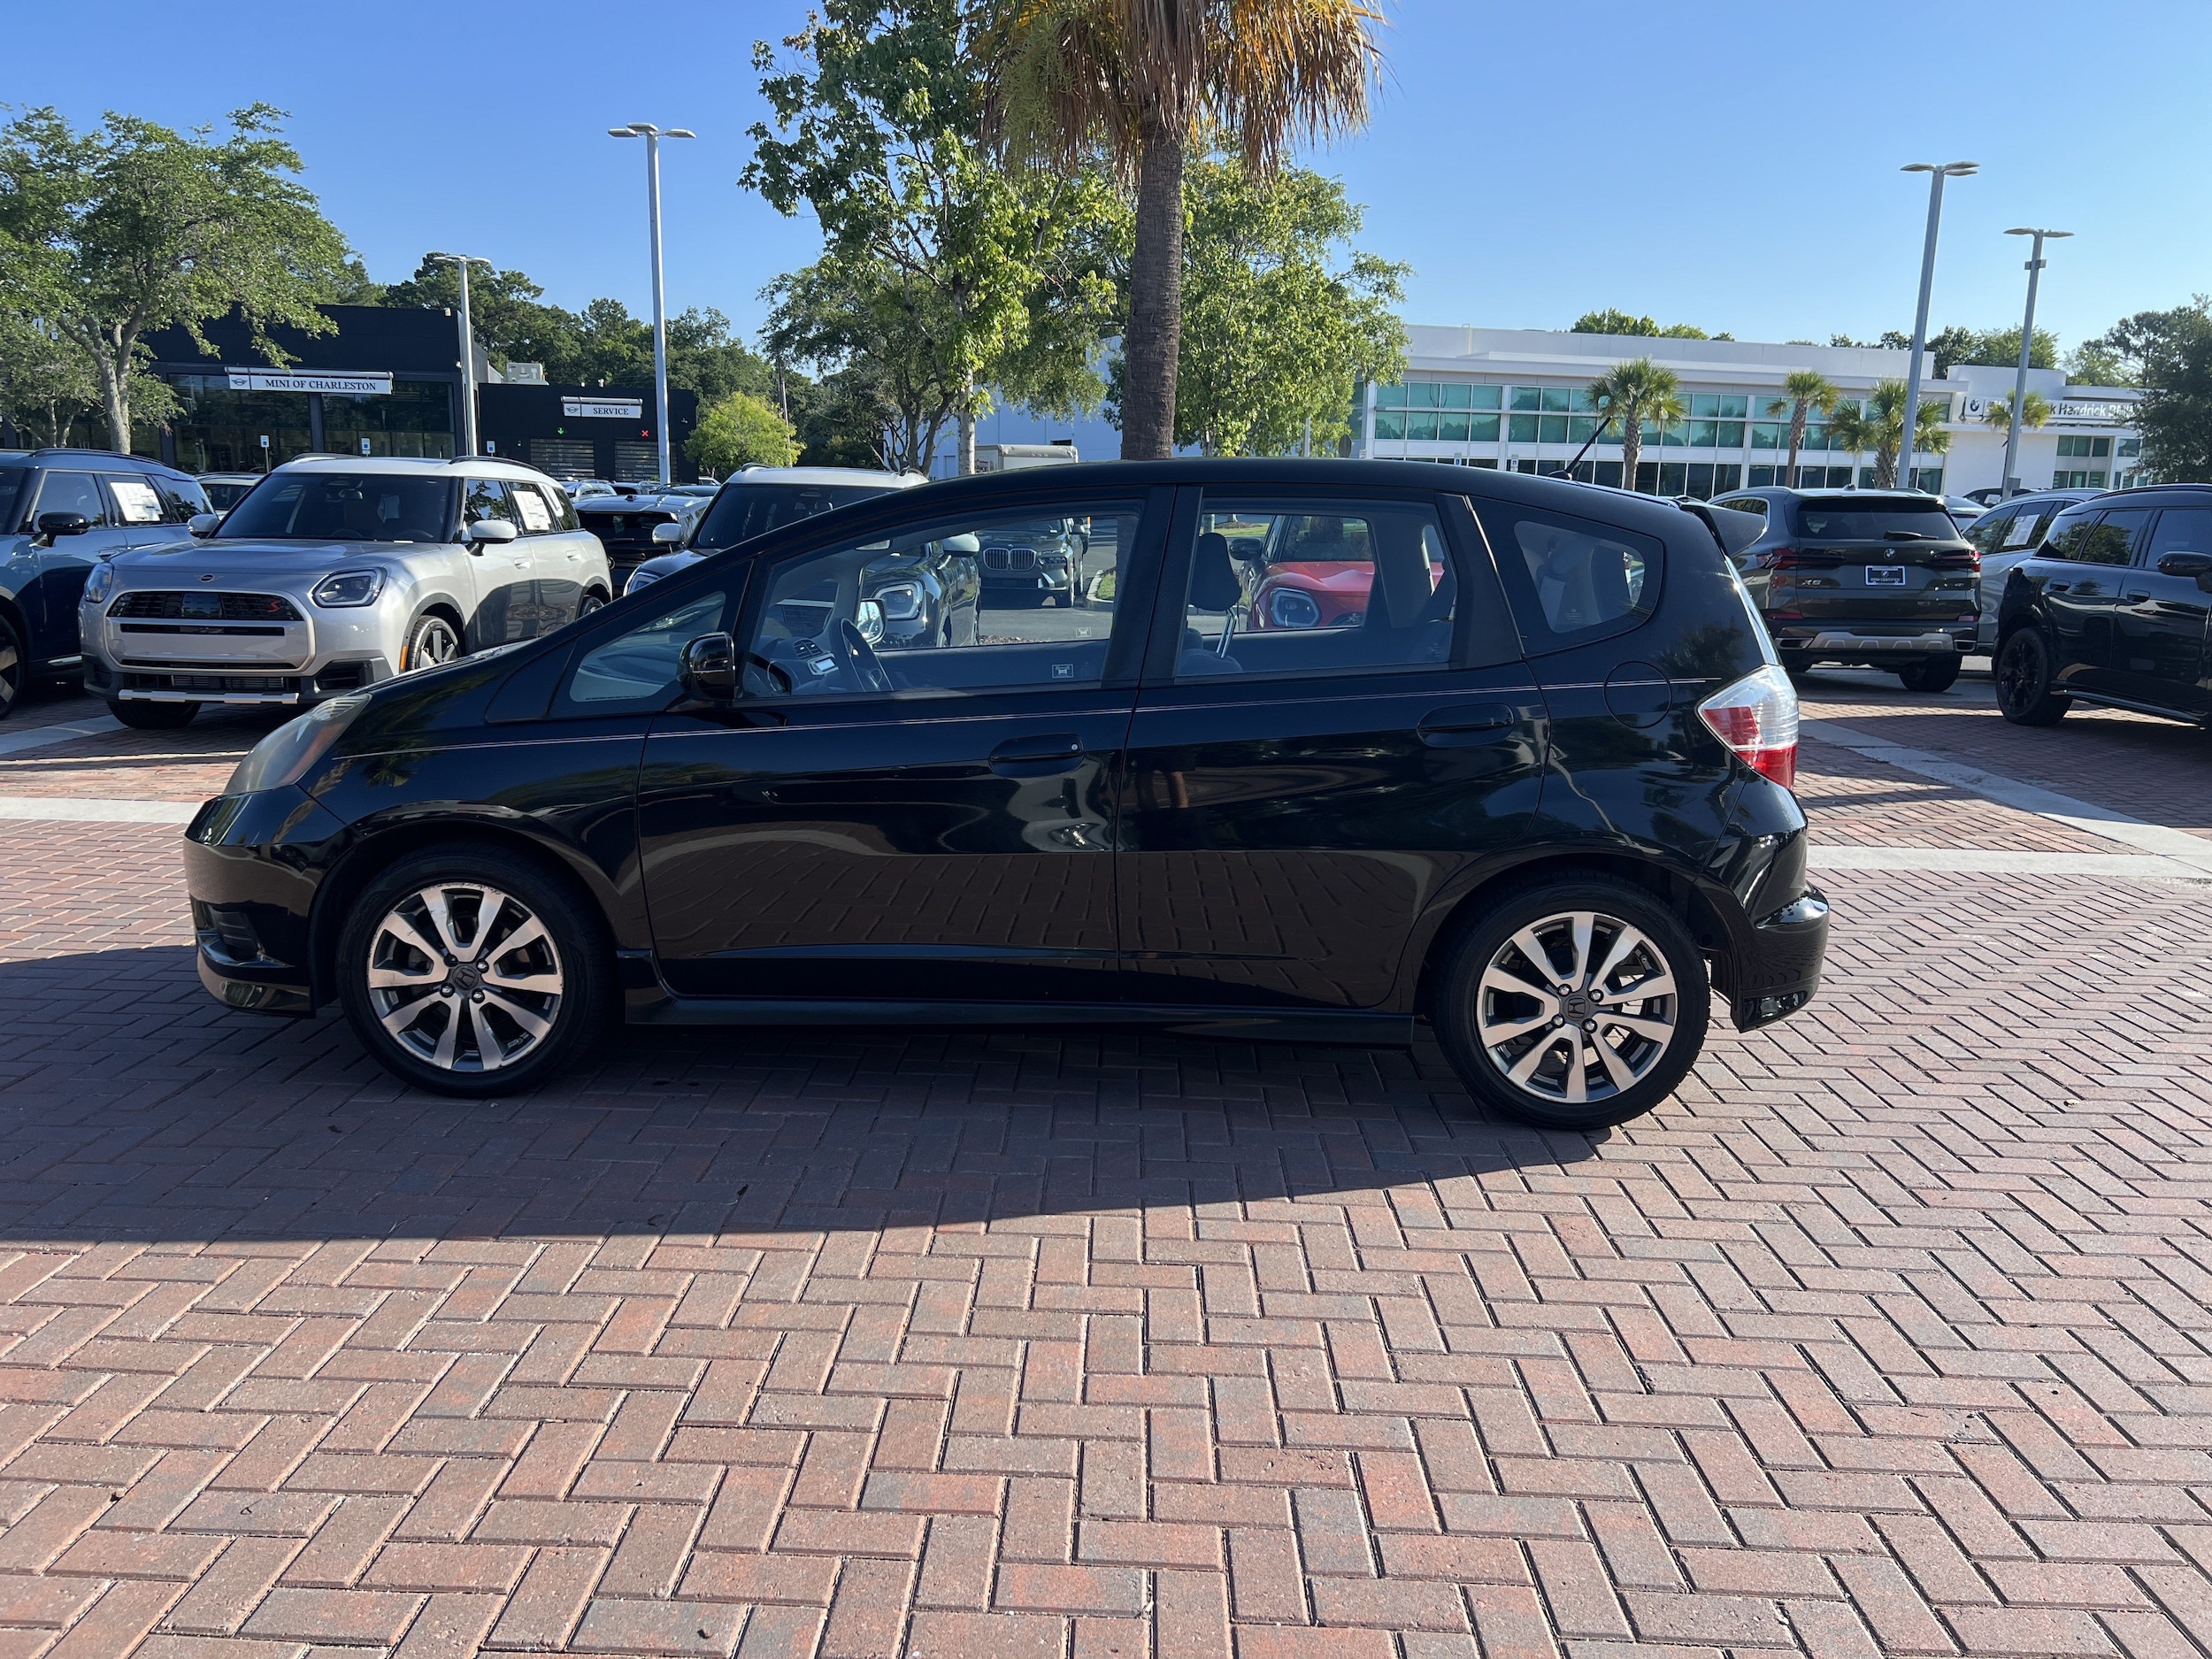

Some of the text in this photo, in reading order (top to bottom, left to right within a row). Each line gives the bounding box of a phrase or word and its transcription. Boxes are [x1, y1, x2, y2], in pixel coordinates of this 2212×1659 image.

[265, 379, 376, 390] MINI OF CHARLESTON
[2058, 403, 2106, 417] Hendrick
[267, 600, 281, 613] S
